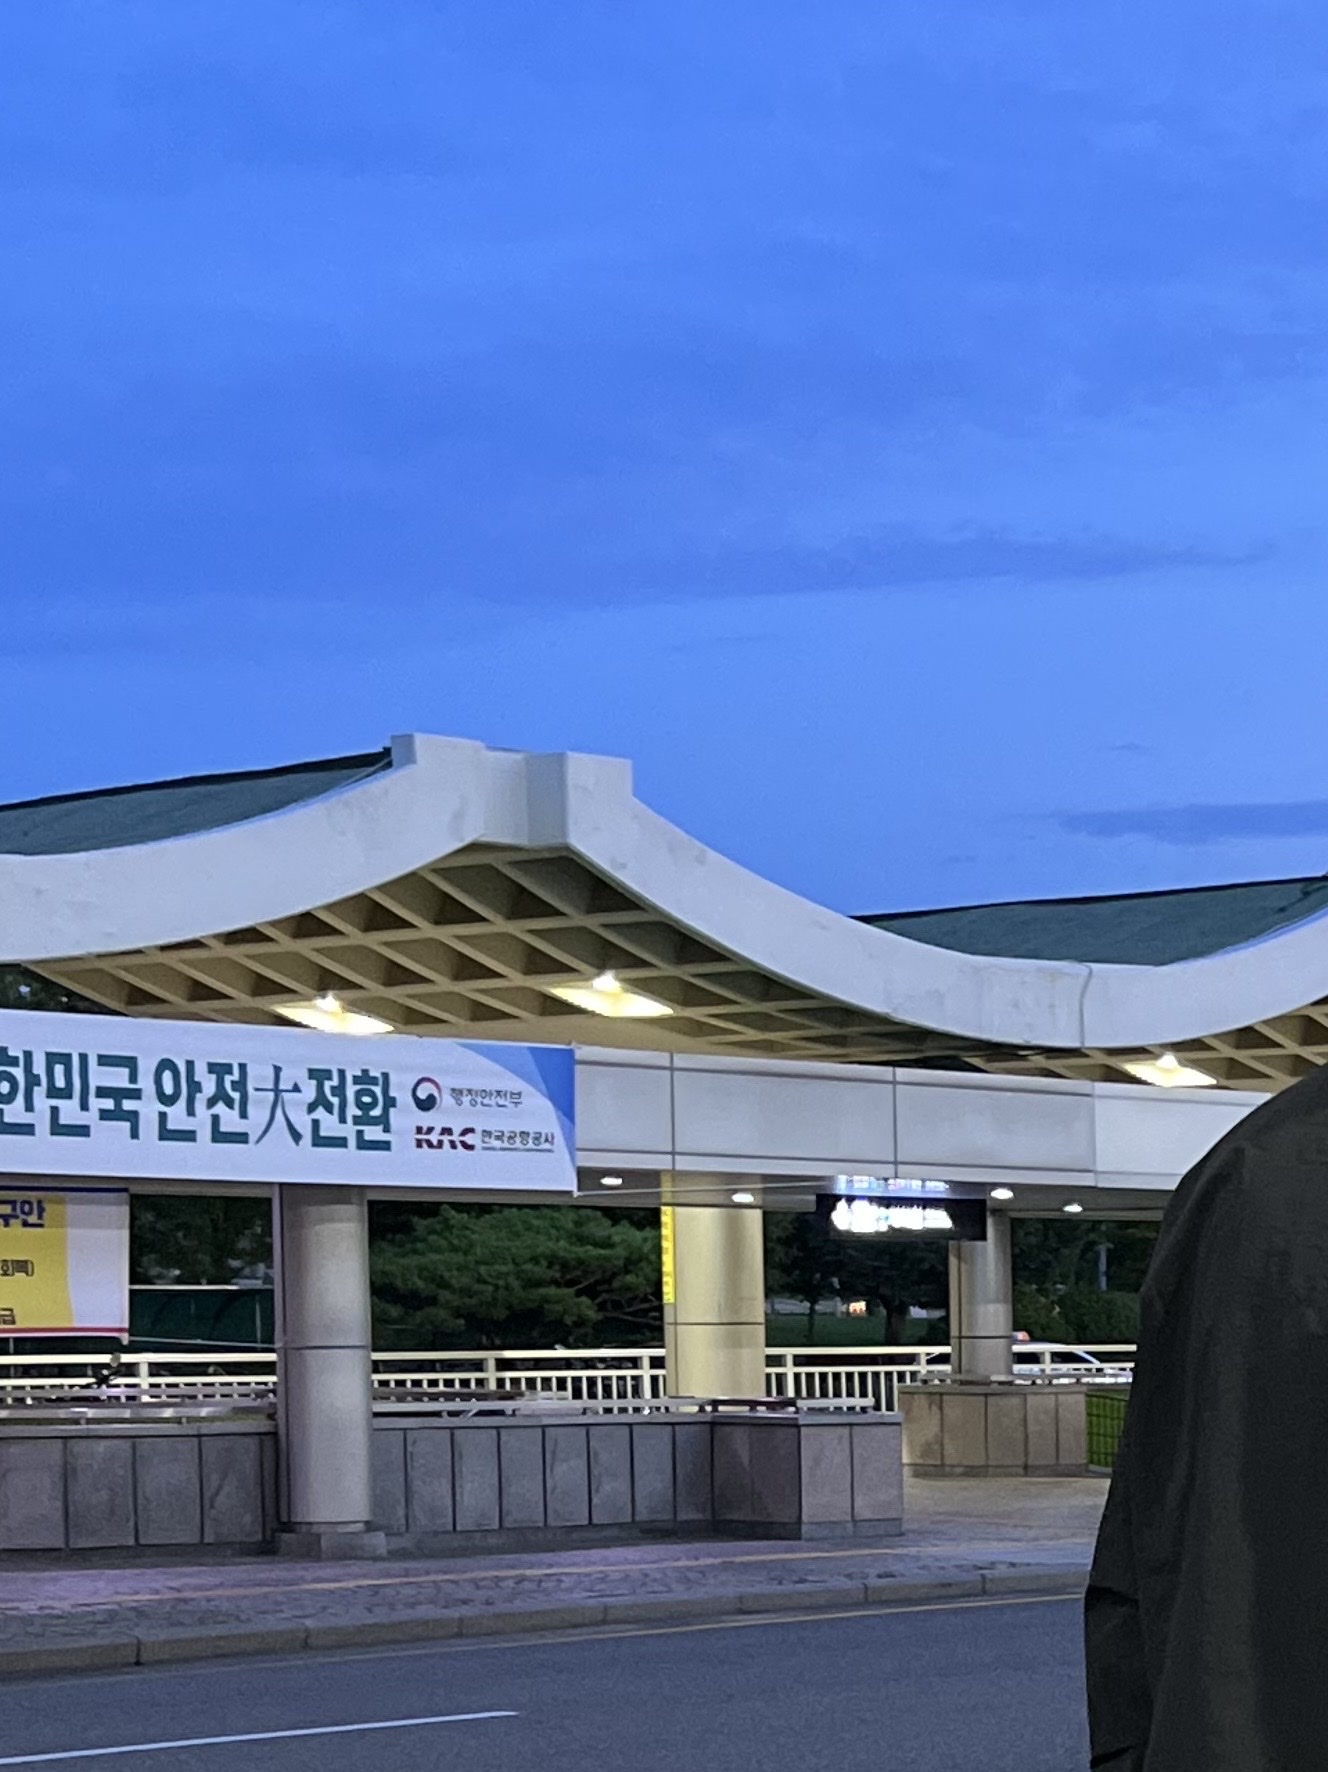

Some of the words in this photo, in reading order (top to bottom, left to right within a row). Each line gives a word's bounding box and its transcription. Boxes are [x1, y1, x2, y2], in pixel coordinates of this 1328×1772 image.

[0, 1046, 143, 1140] 한민국
[450, 1087, 522, 1108] 행정안전부
[414, 1125, 476, 1151] KAC
[481, 1129, 555, 1147] 한국공항공사
